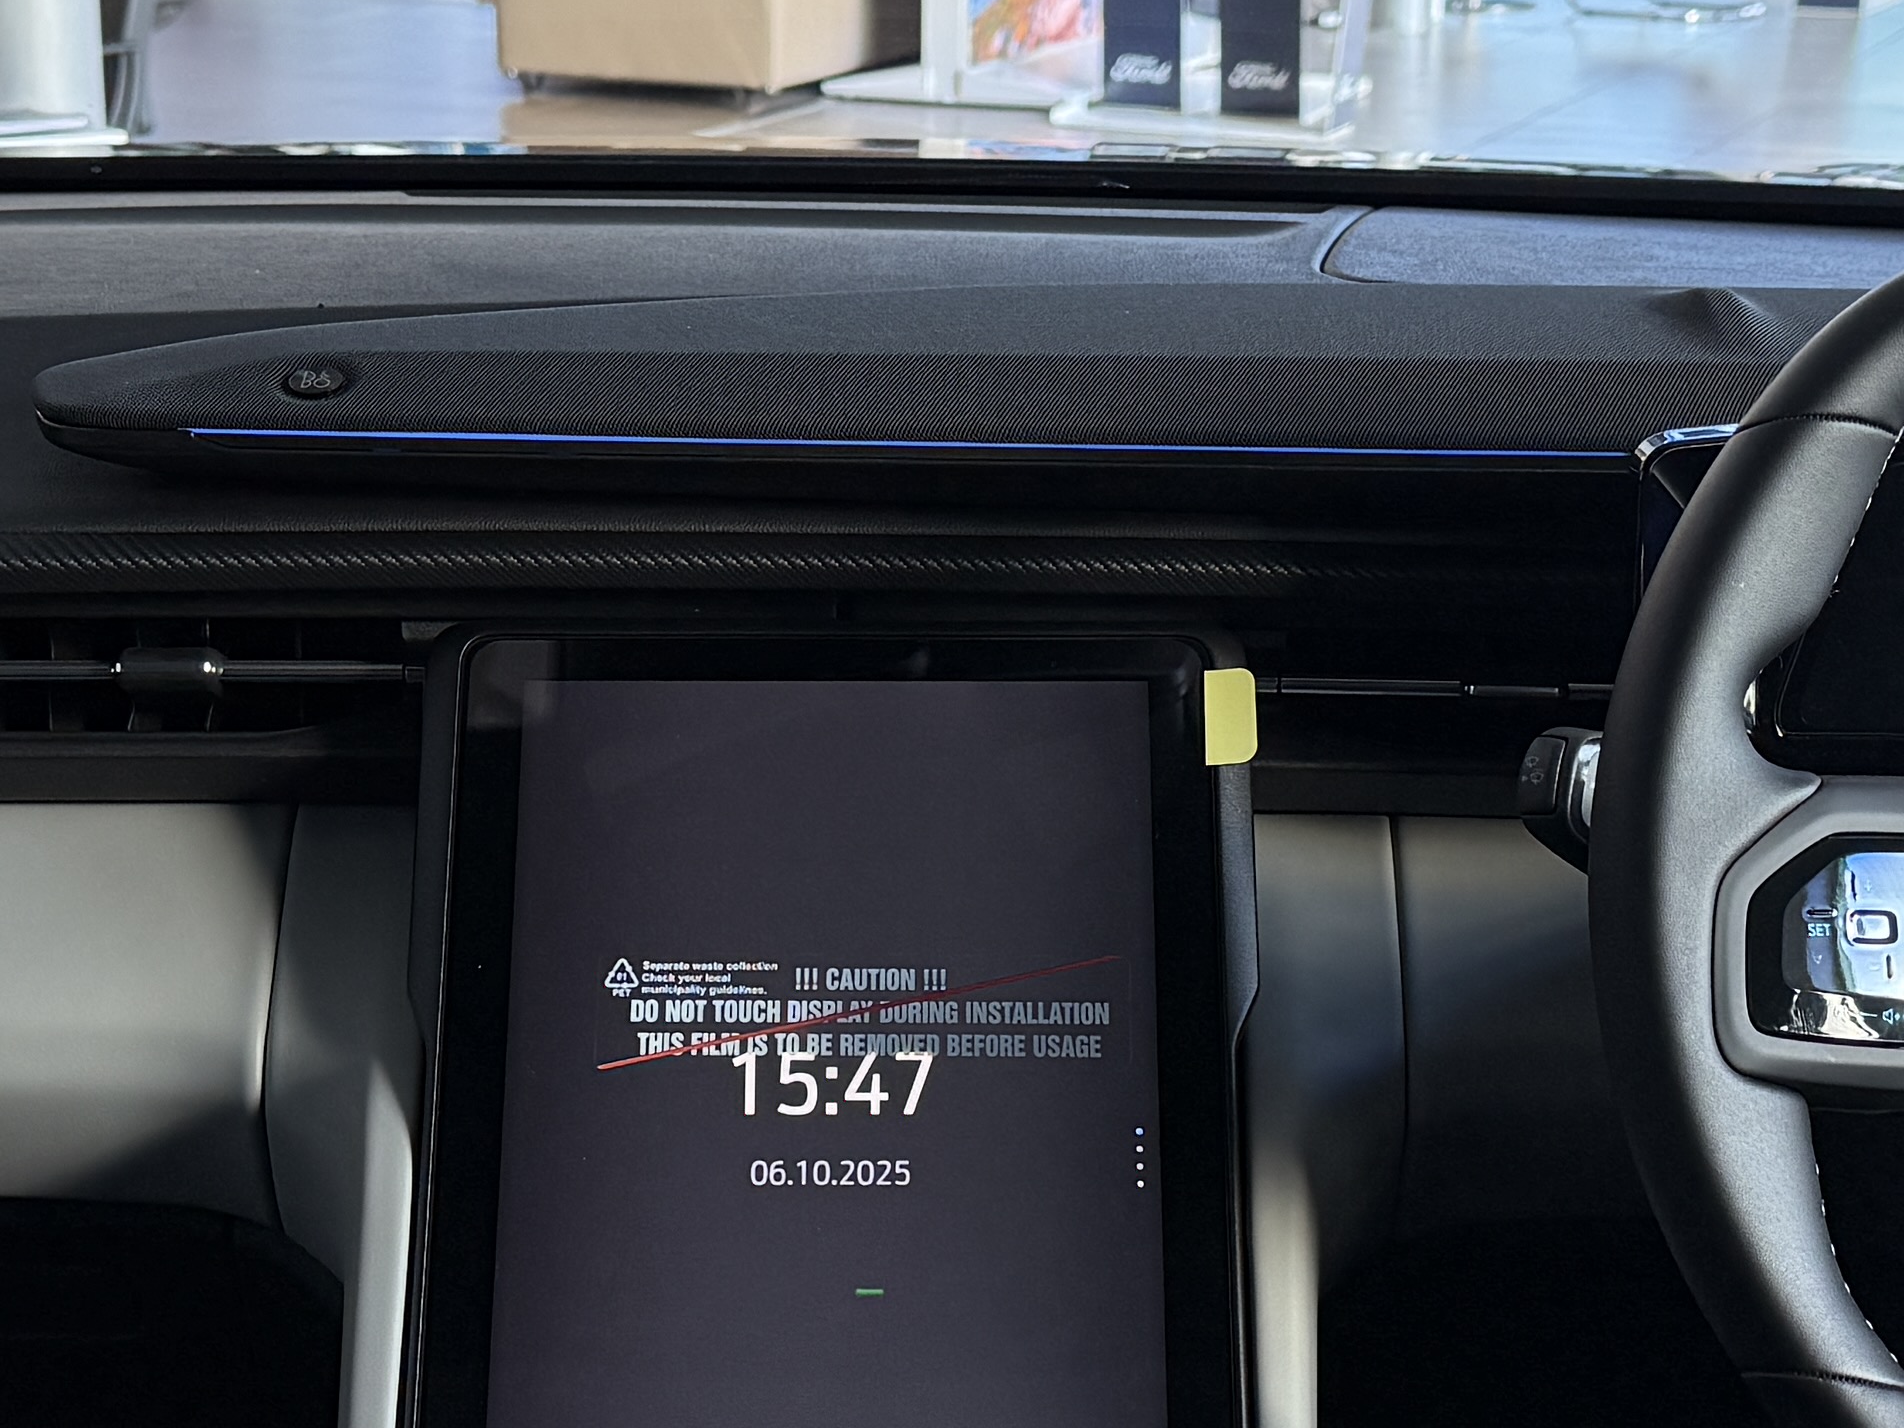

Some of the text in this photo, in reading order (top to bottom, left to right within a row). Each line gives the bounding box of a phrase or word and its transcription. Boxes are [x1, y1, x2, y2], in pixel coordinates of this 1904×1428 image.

[1807, 923, 1831, 938] SET
[642, 961, 778, 972] Separate waste collection
[641, 973, 732, 984] Check your local
[795, 967, 946, 991] !!! CAUTION !!!
[612, 989, 632, 997] PET
[641, 985, 707, 996] municipality
[630, 999, 1110, 1025] DO NOT TOUCH DISPLAY DURING INSTALLATION
[637, 1032, 1102, 1058] THIS FILM IS TO BE REMOVED BEFORE USAGE
[732, 1051, 935, 1116] 15:47
[750, 1160, 911, 1186] 06.10.2025
